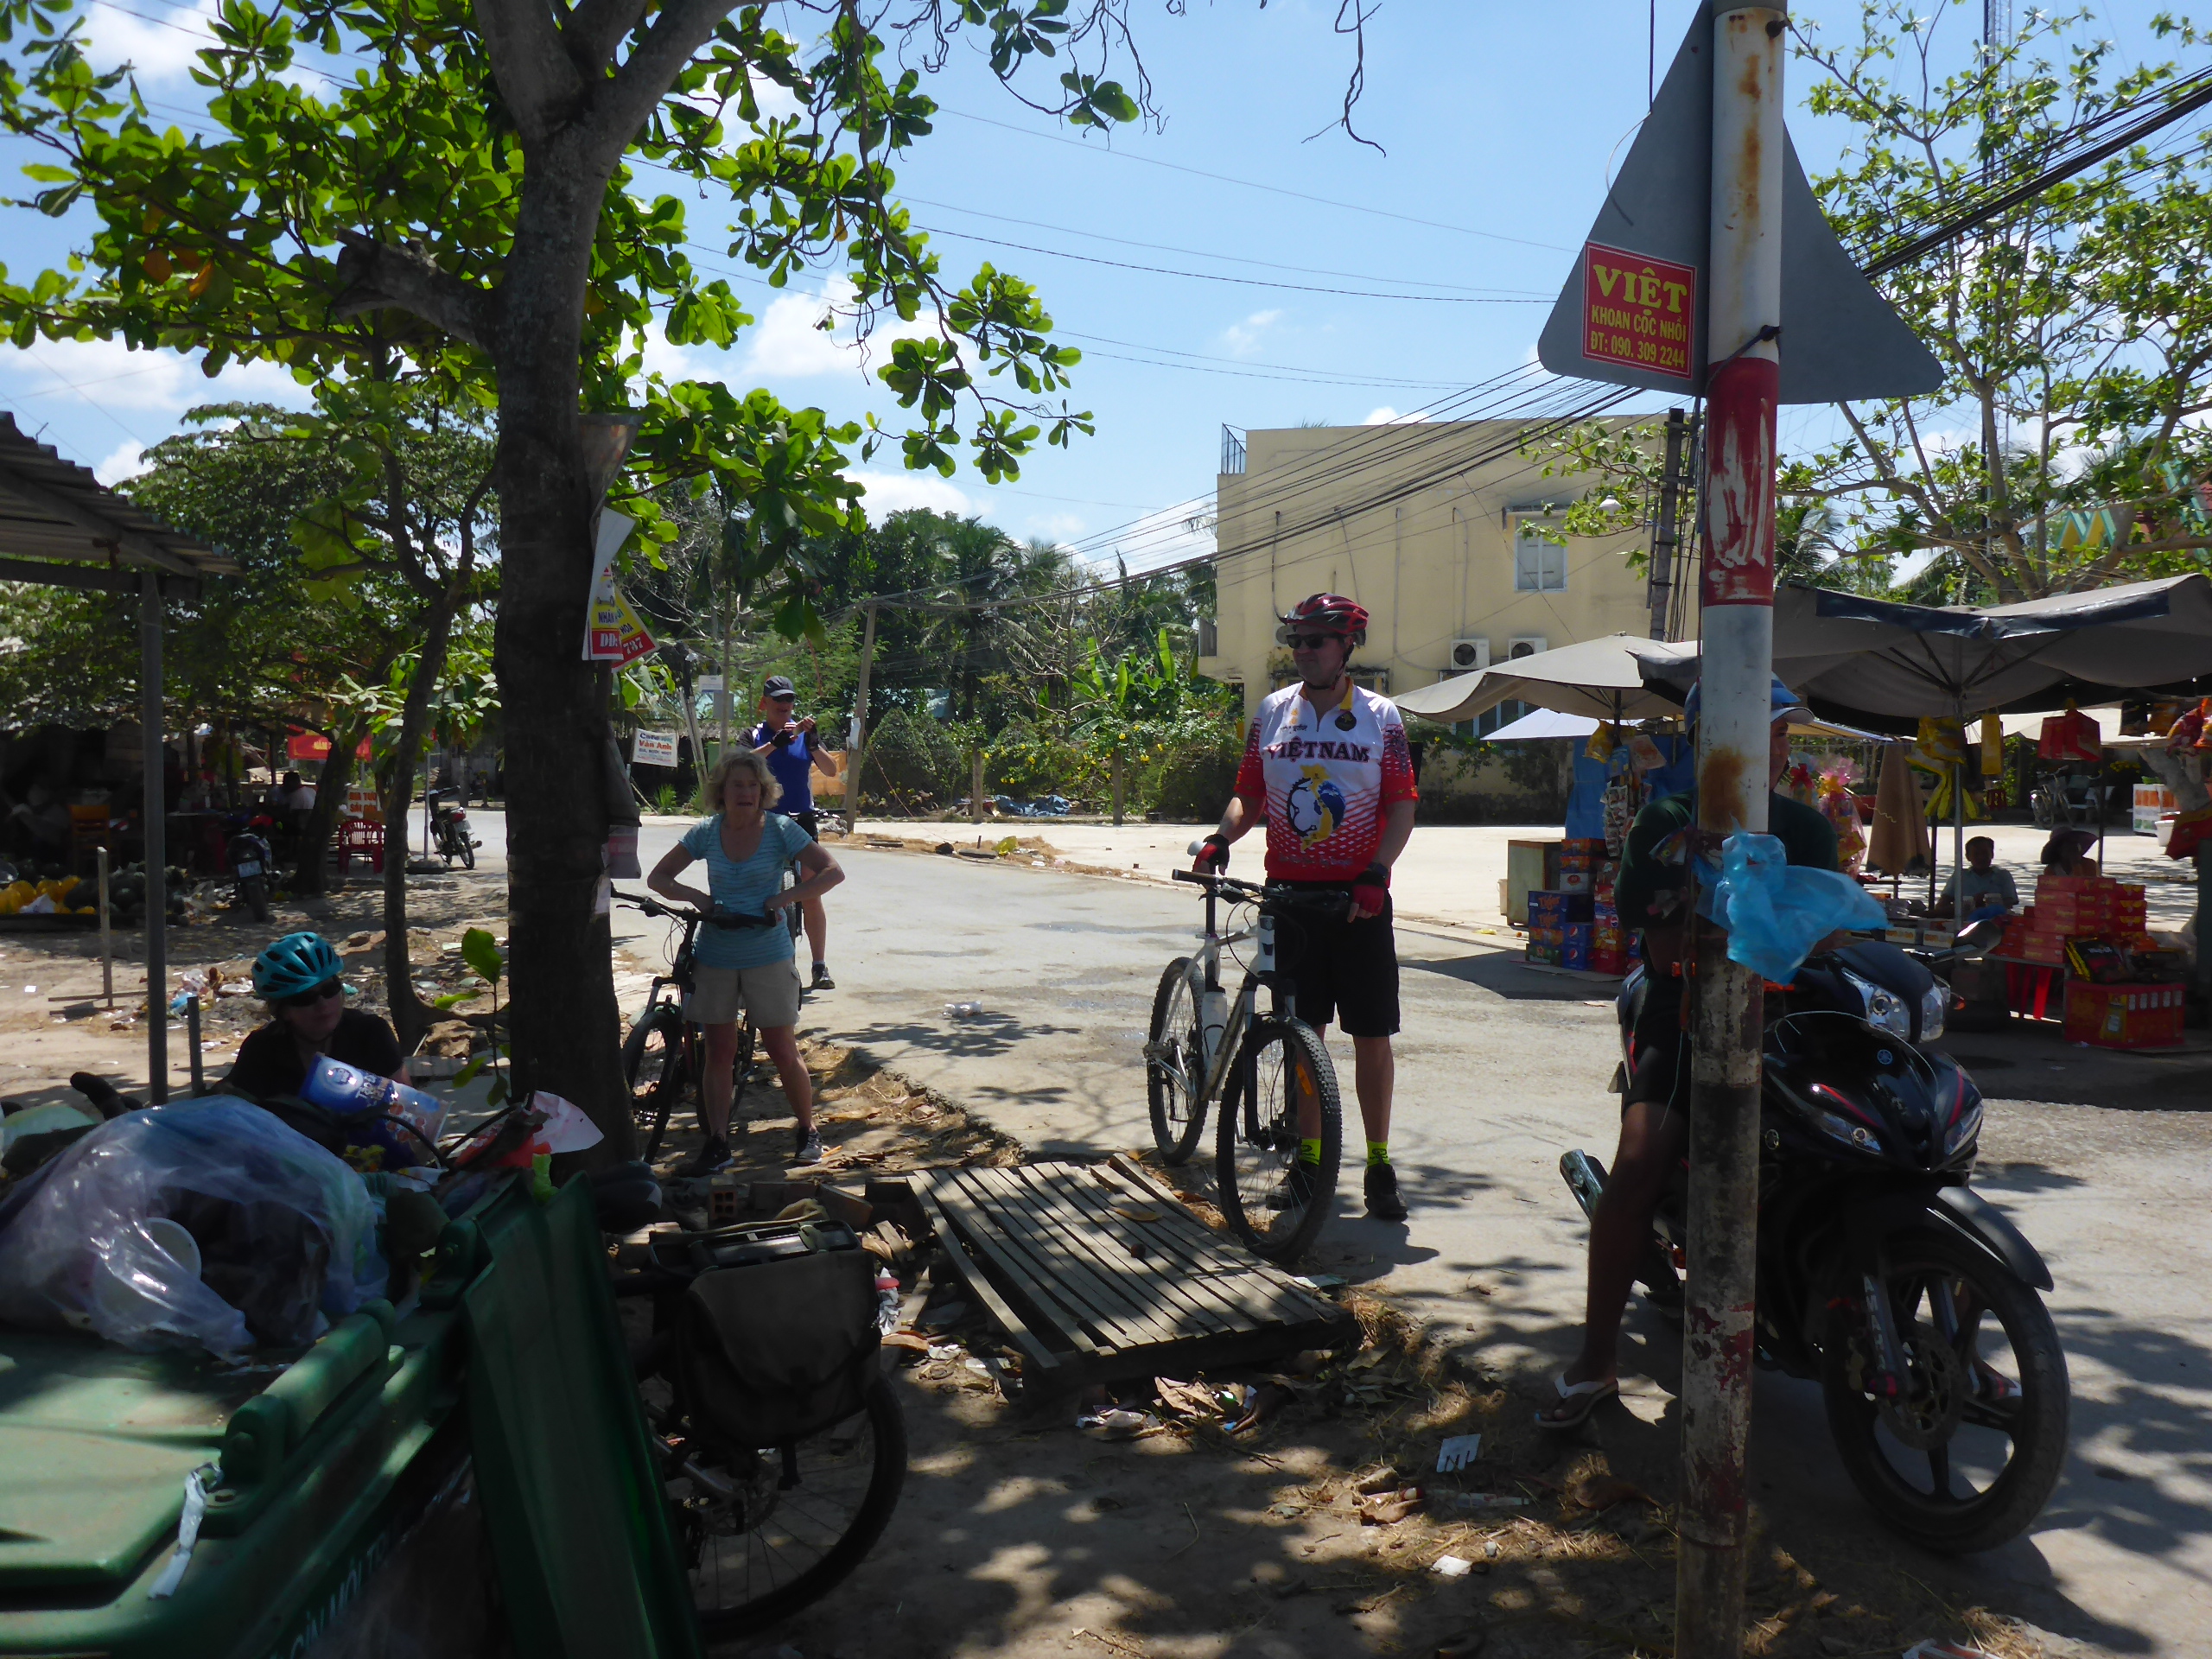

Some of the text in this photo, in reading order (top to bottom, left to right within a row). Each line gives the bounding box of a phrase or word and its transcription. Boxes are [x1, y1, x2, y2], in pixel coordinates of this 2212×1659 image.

[1592, 264, 1688, 316] VIỆT
[1591, 304, 1630, 331] KHOAN
[1659, 316, 1687, 342] NHỒI
[1591, 330, 1686, 368] ĐT: 090. 309 2244
